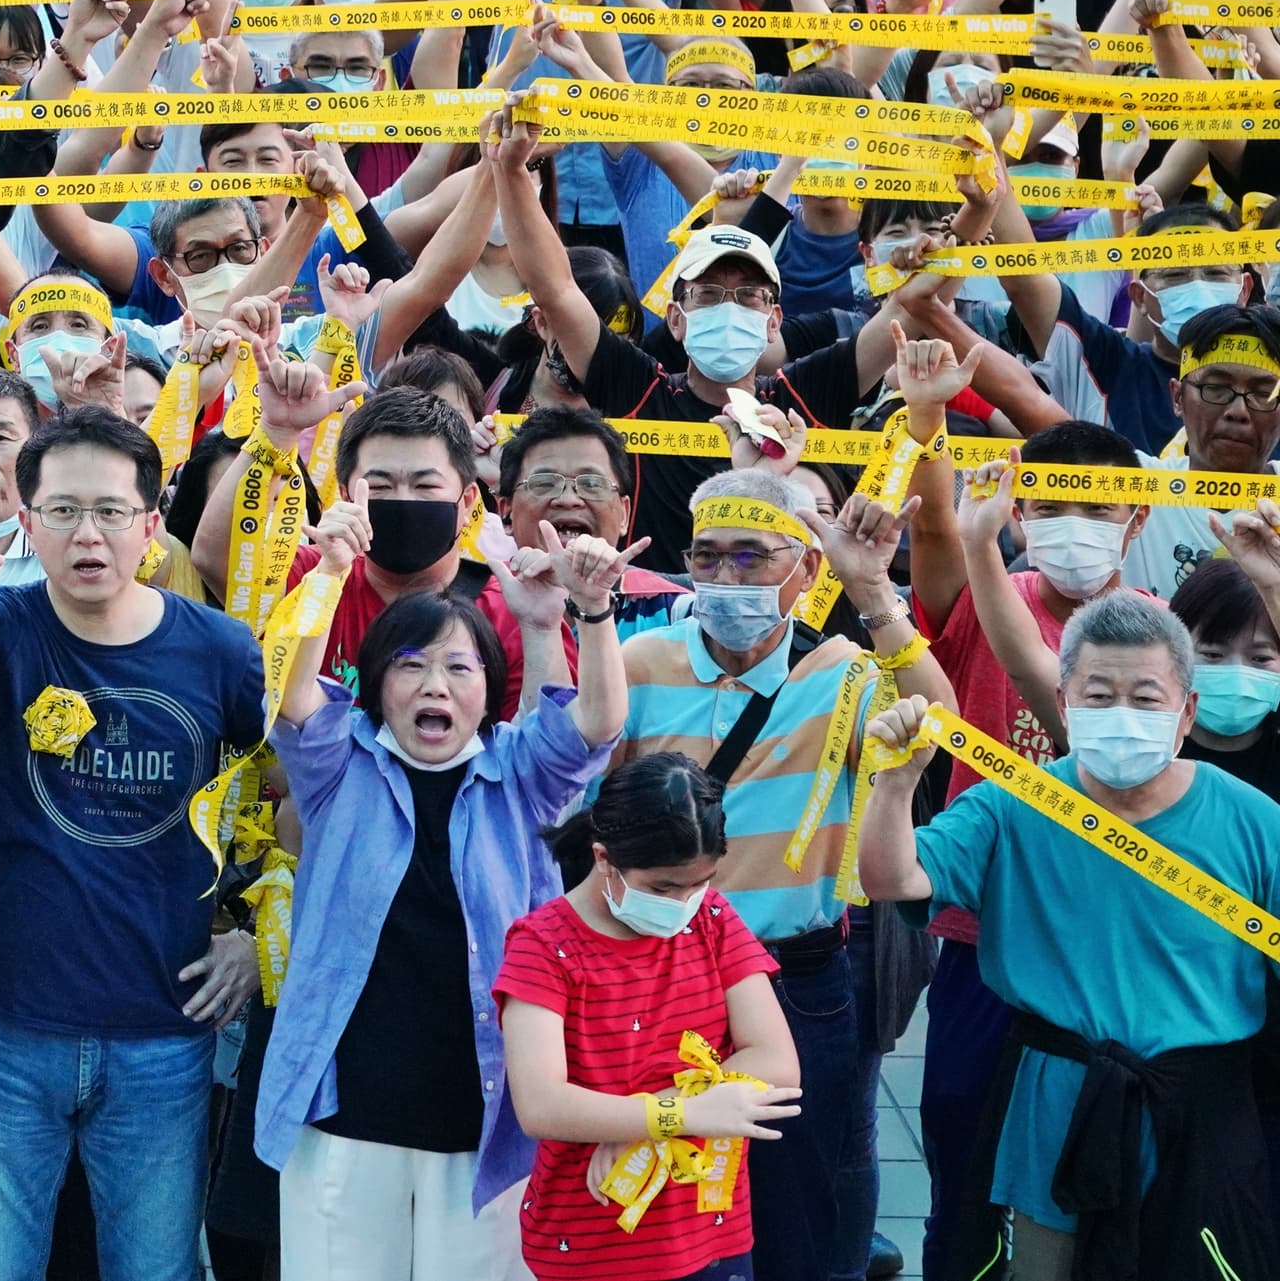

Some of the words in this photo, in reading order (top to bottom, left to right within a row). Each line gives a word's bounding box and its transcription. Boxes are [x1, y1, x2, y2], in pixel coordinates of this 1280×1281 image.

[620, 11, 657, 25] 0606
[659, 12, 706, 28] 光復高雄
[731, 15, 767, 29] 2020
[769, 16, 843, 33] 高雄人寫歷史
[868, 18, 906, 32] 0606
[909, 17, 959, 34] 天佑台灣
[53, 104, 93, 119] 0606
[94, 101, 148, 120] 光復高雄
[176, 100, 215, 115] 2020
[218, 97, 300, 115] 高雄人寫歷史
[328, 94, 369, 110] 0606
[371, 90, 426, 109] 天佑台灣
[434, 90, 462, 107] We
[464, 88, 501, 106] Vote
[994, 249, 1037, 268] 0606
[1039, 247, 1099, 267] 光復高雄
[1130, 244, 1173, 262] 2020
[1175, 236, 1268, 261] 高雄人寫歷史
[30, 288, 67, 305] 2020
[1045, 473, 1093, 491] 0606
[1095, 475, 1160, 495] 光復高雄
[1195, 479, 1242, 497] 2020
[61, 748, 175, 781] ADELAIDE
[71, 778, 86, 790] THE
[88, 780, 104, 792] CITY
[107, 782, 117, 793] OF
[118, 782, 163, 795] CHURCHES
[970, 742, 1018, 781] 0606
[1013, 770, 1077, 819] 光復高雄
[1101, 825, 1150, 865] 2020
[1147, 853, 1242, 923] 高雄人寫歷史
